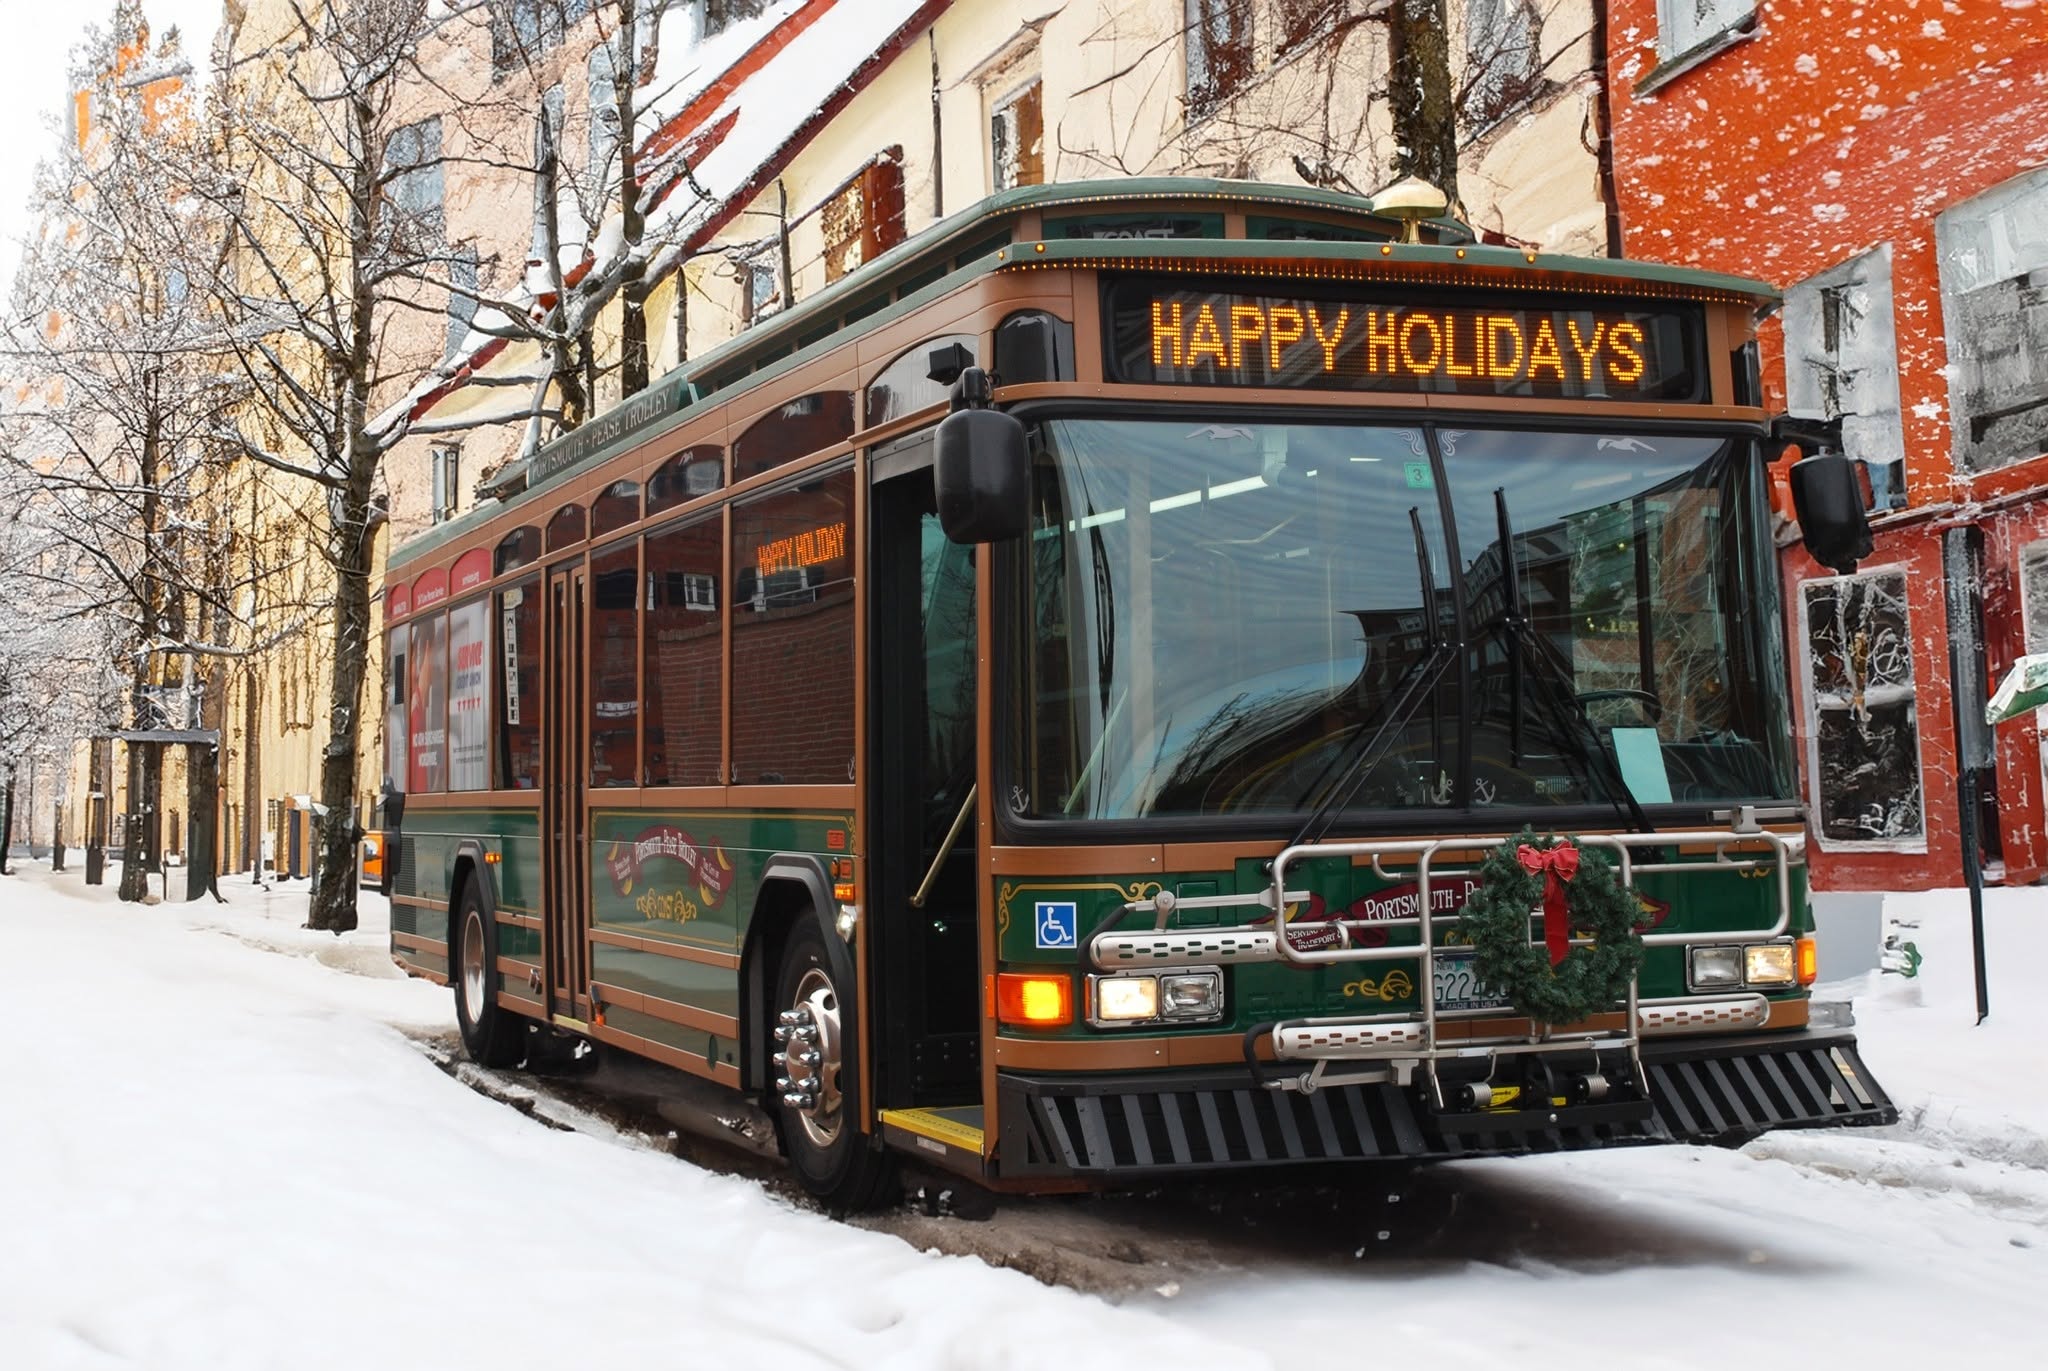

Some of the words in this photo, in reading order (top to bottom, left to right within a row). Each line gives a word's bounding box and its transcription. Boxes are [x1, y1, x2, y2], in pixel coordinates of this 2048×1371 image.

[1152, 302, 1349, 371] HAPPY
[1368, 311, 1645, 382] HOLIDAYS
[592, 419, 621, 448] PEASE
[624, 388, 671, 430] TROLLEY
[757, 537, 793, 577] HAPPY
[1364, 889, 1454, 920] PORTSMUTH
[1481, 1000, 1498, 1008] USA
